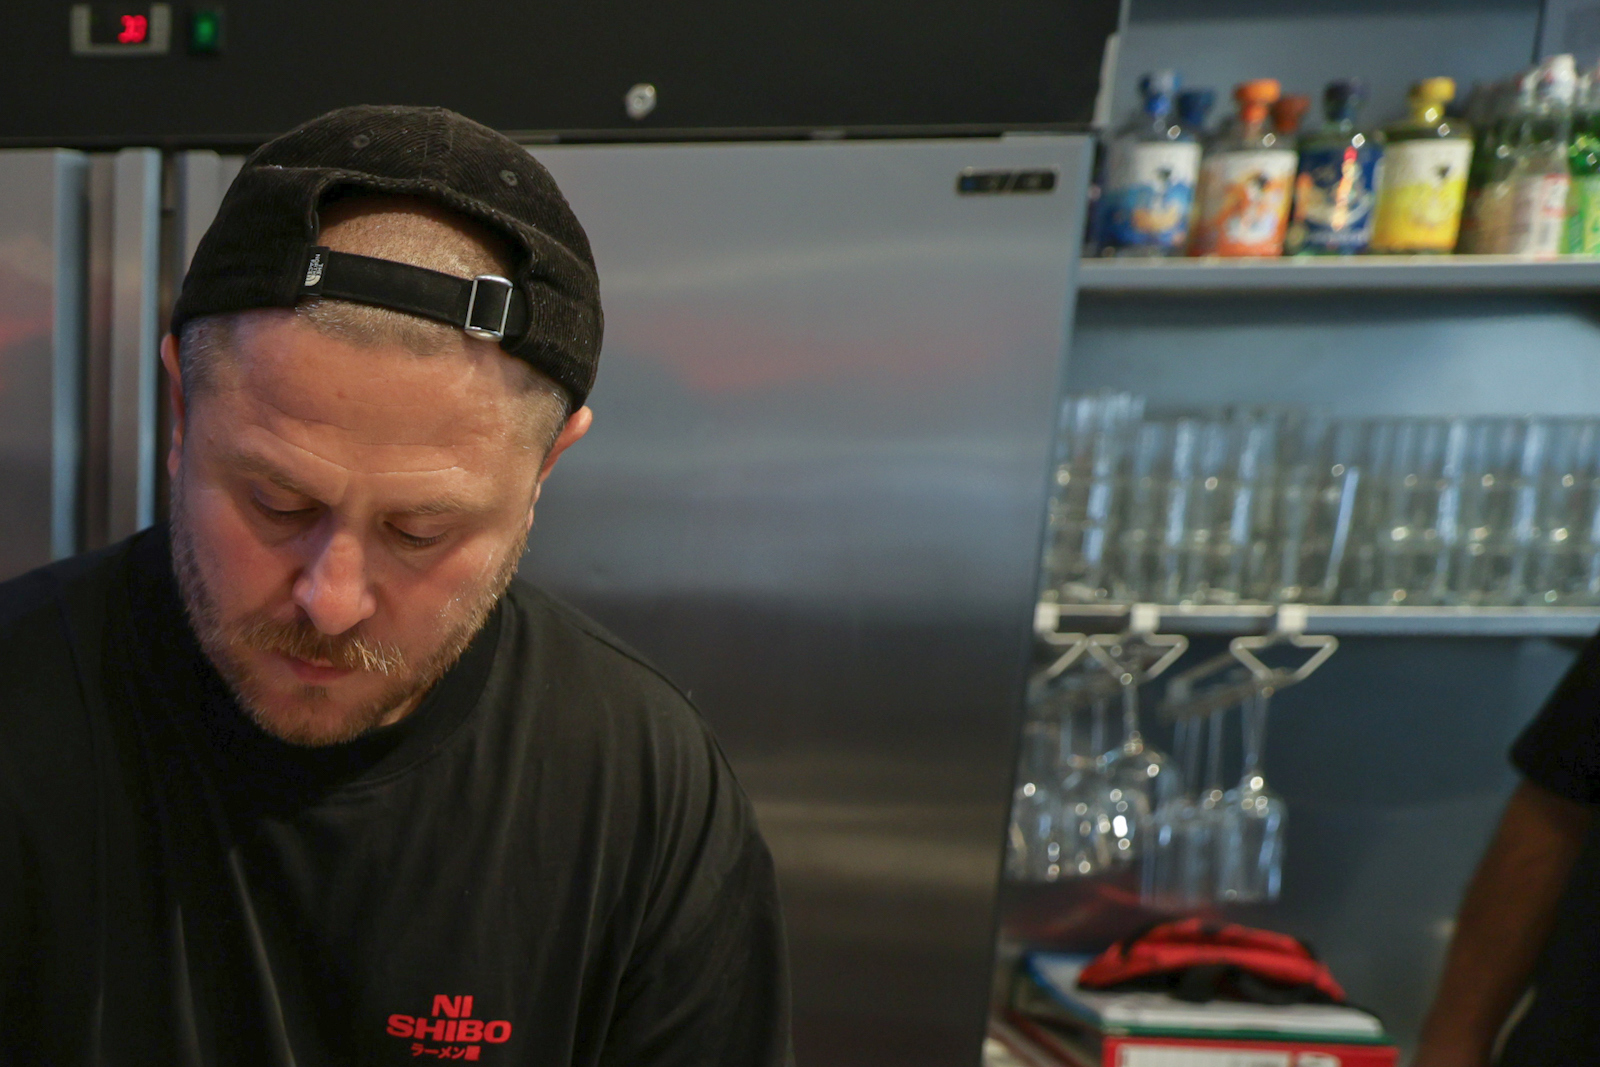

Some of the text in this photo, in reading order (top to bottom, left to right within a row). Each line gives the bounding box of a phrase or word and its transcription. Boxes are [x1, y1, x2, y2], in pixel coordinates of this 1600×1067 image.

[306, 259, 316, 276] FACE
[312, 253, 321, 276] NORTH
[316, 263, 324, 276] THE
[431, 993, 474, 1018] NI
[385, 1013, 512, 1044] SHIBO
